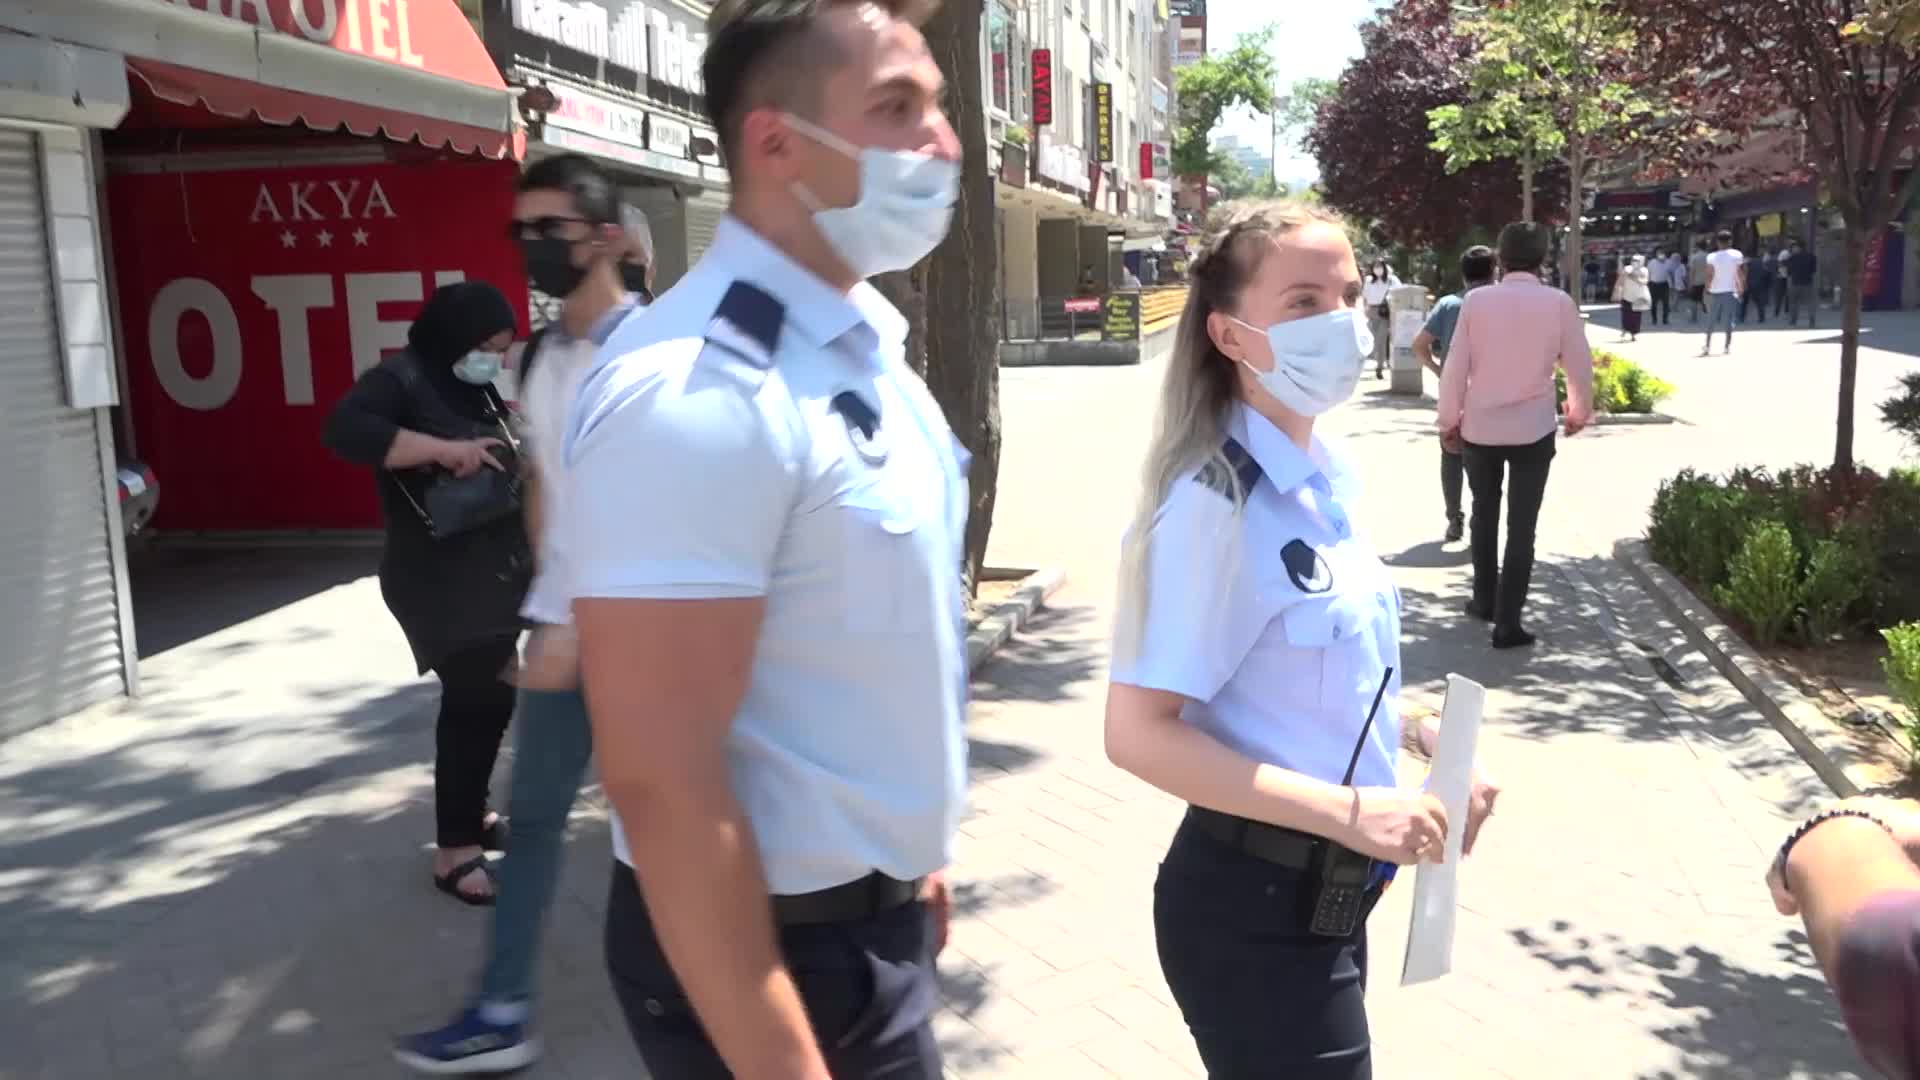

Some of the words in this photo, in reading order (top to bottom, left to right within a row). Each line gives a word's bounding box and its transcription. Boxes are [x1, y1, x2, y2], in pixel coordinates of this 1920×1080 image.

[1033, 50, 1050, 123] BAYAN
[250, 178, 398, 223] AKYA
[148, 270, 466, 411] OTE
